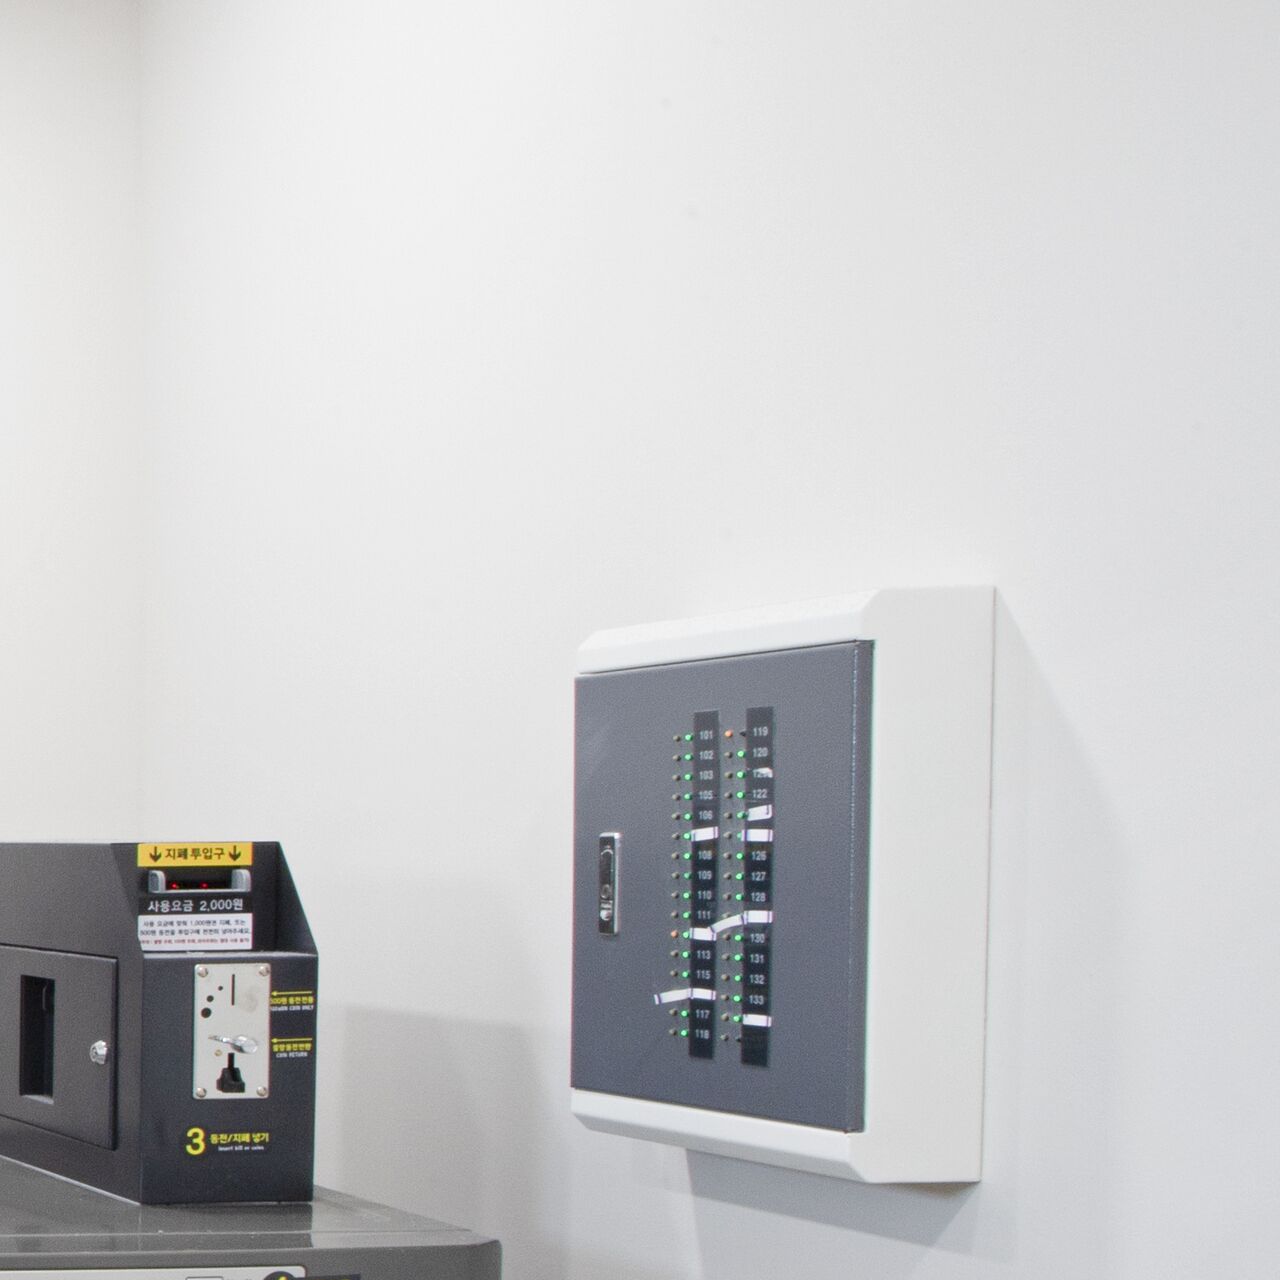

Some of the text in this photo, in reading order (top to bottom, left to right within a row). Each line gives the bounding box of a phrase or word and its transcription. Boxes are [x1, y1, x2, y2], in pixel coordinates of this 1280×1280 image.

[753, 727, 768, 736] 119
[753, 748, 768, 757] 120
[752, 790, 767, 798] 122
[165, 848, 224, 860] 지폐 투입구
[752, 872, 766, 881] 127
[698, 891, 711, 900] 110
[148, 899, 243, 913] 사용요금 2,000원
[698, 911, 711, 919] 111
[750, 934, 765, 943] 130
[697, 951, 711, 959] 113
[750, 954, 764, 963] 131
[697, 970, 711, 979] 115
[750, 975, 764, 984] 132
[749, 995, 764, 1005] 133
[696, 1010, 710, 1019] 117
[186, 1127, 206, 1155] 3
